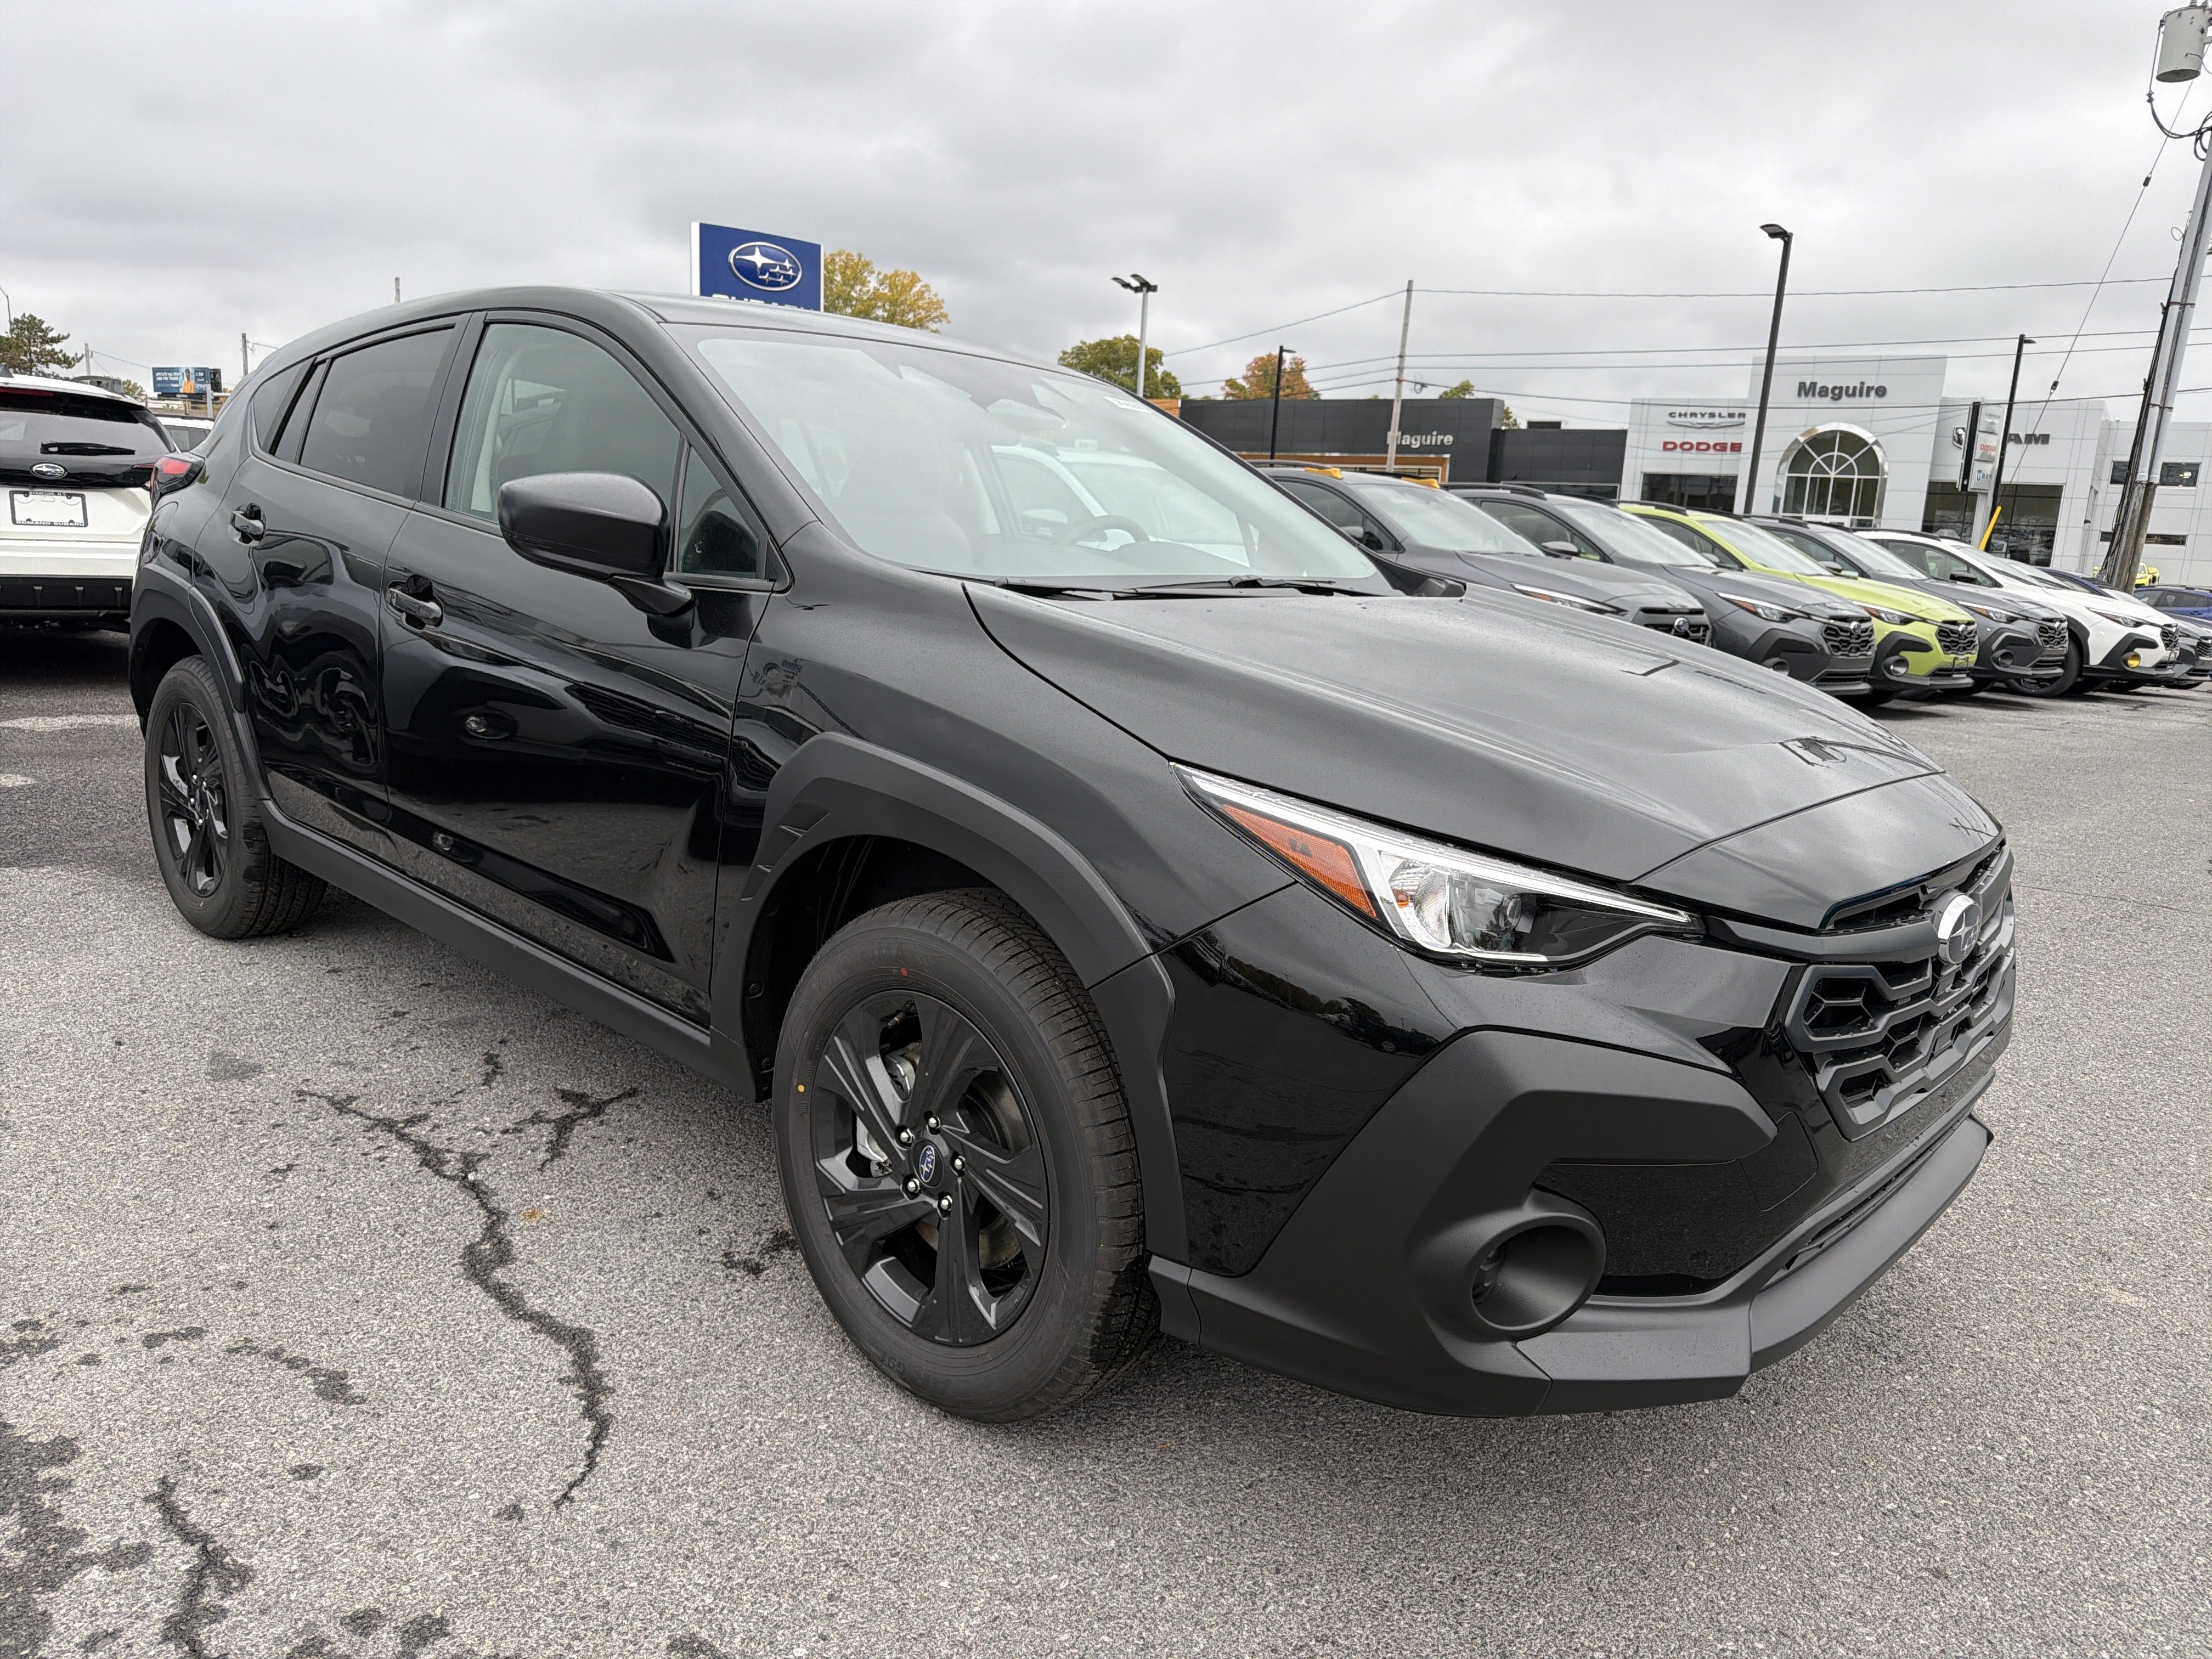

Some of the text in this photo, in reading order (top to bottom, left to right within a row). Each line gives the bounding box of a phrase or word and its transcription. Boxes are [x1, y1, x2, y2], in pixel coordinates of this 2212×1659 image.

[1797, 381, 1887, 400] Maguire
[1662, 441, 1742, 453] DODGE
[1980, 444, 1996, 452] DODGE
